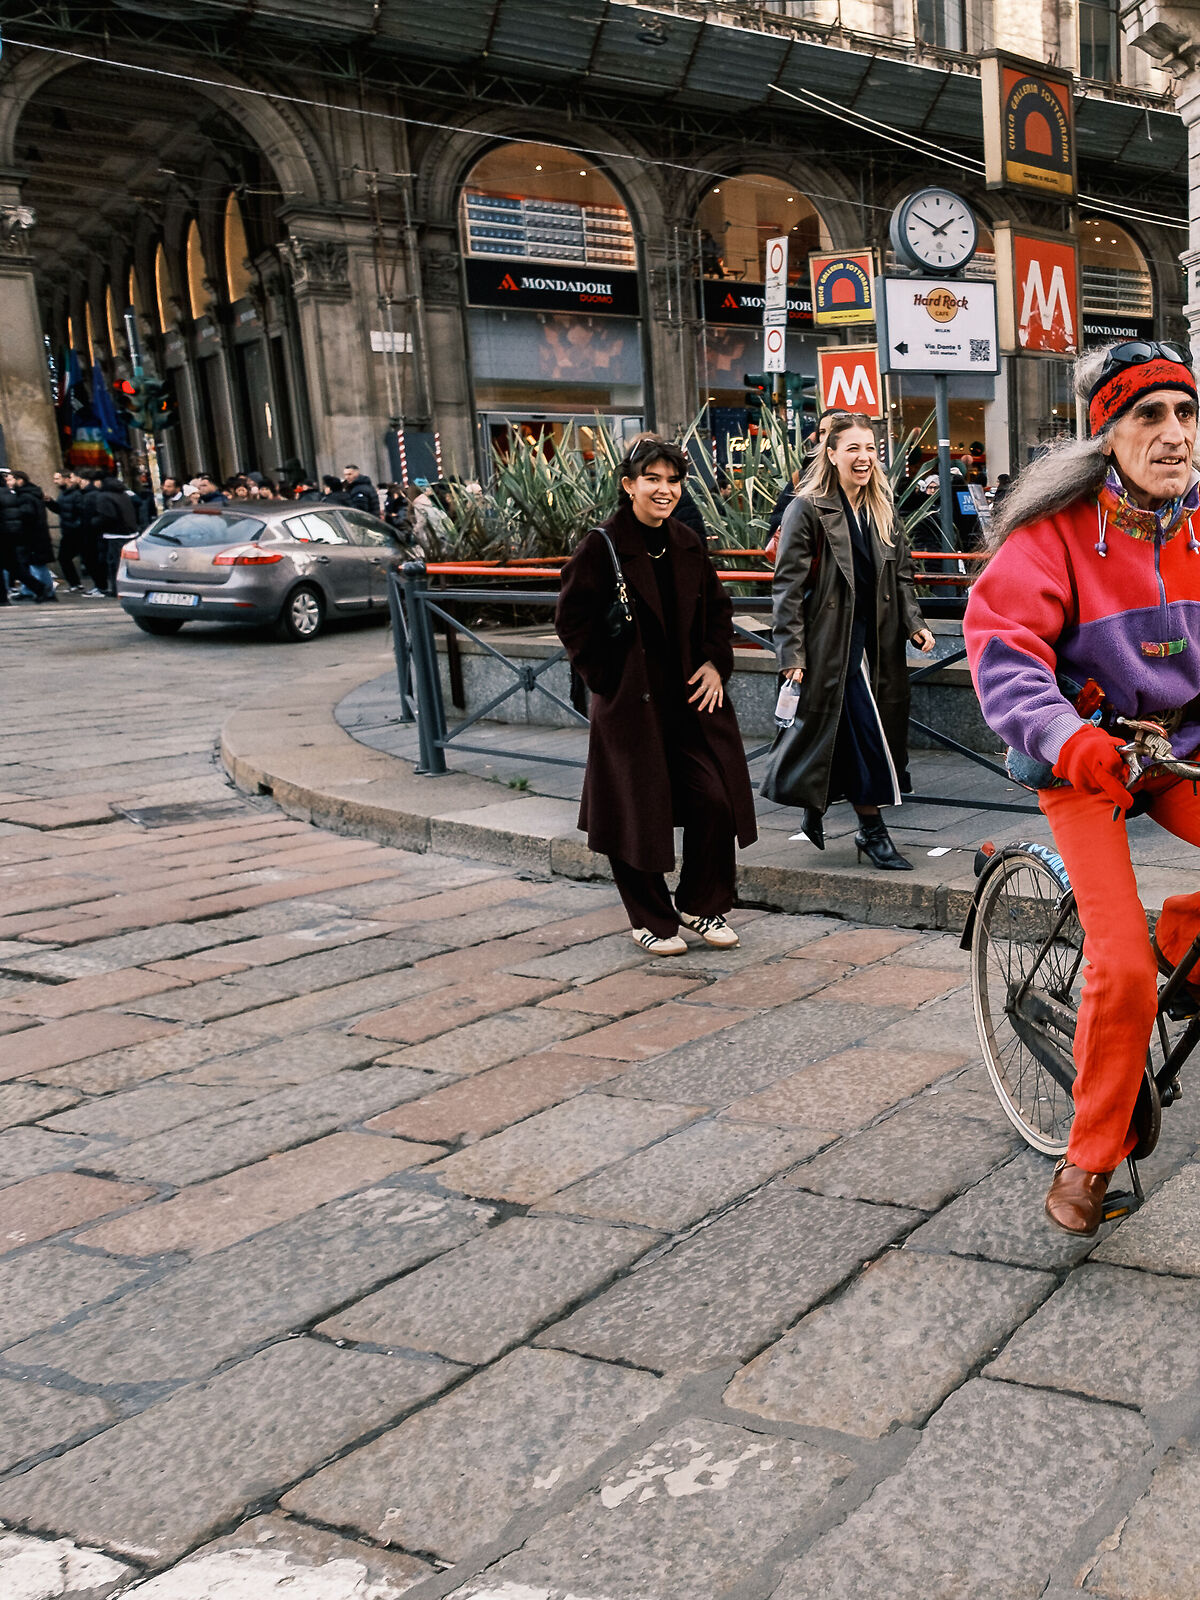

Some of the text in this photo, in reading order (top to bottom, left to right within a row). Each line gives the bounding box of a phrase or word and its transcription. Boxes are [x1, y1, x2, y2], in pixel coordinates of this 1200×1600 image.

[521, 276, 613, 295] MONDADORI
[579, 294, 614, 304] DUOMO
[913, 294, 969, 310] Hard Rock
[1020, 259, 1074, 335] M
[1083, 325, 1138, 337] MONDADORI
[827, 365, 876, 407] M
